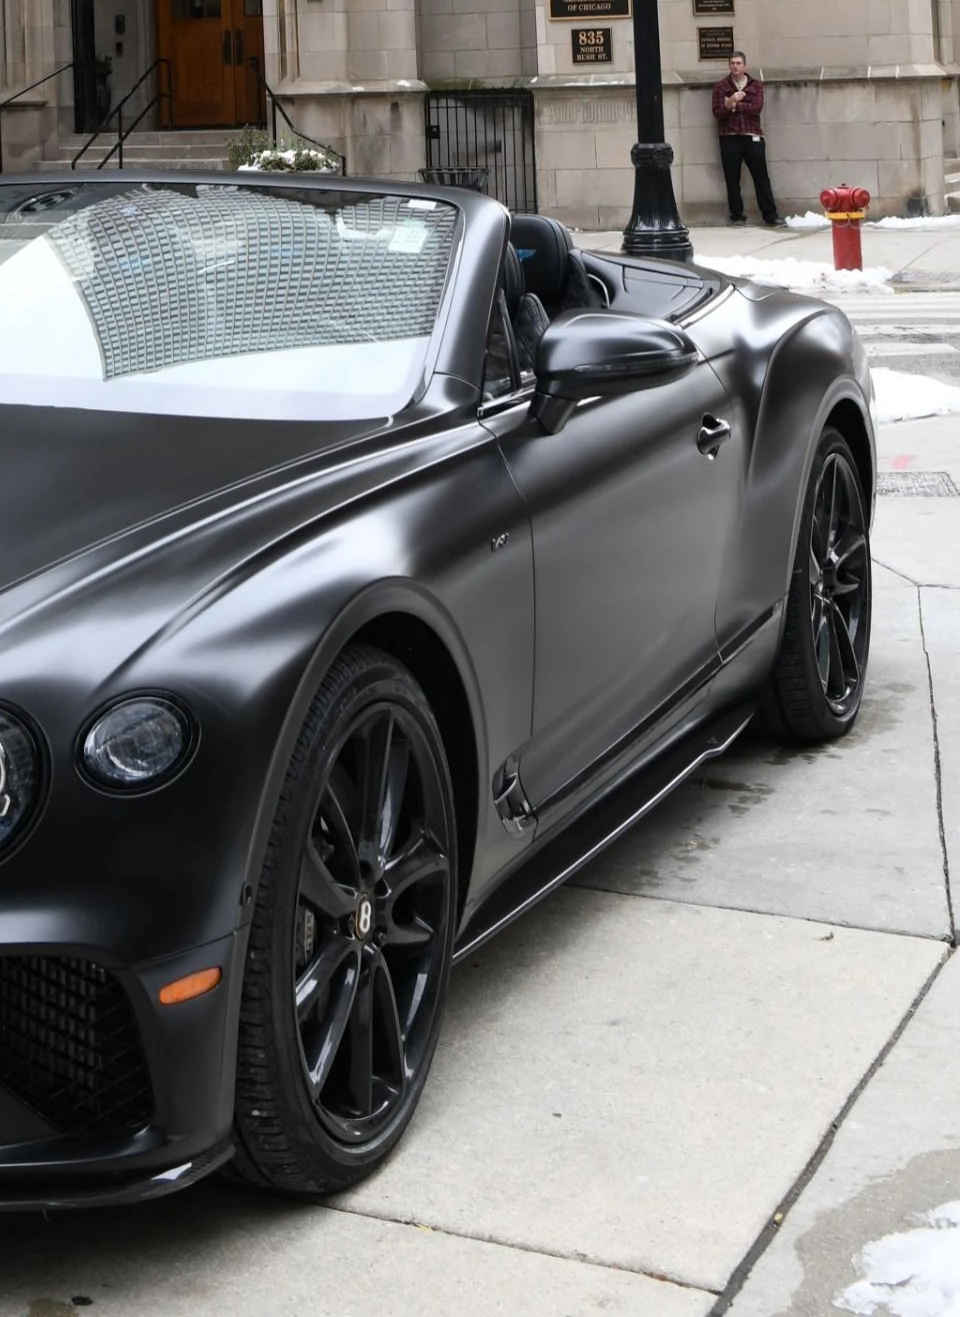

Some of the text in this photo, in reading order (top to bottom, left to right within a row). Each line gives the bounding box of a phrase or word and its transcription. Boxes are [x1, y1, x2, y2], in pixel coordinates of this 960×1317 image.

[578, 3, 611, 11] CHICAGO
[578, 30, 604, 45] 835
[580, 46, 604, 54] NORTH
